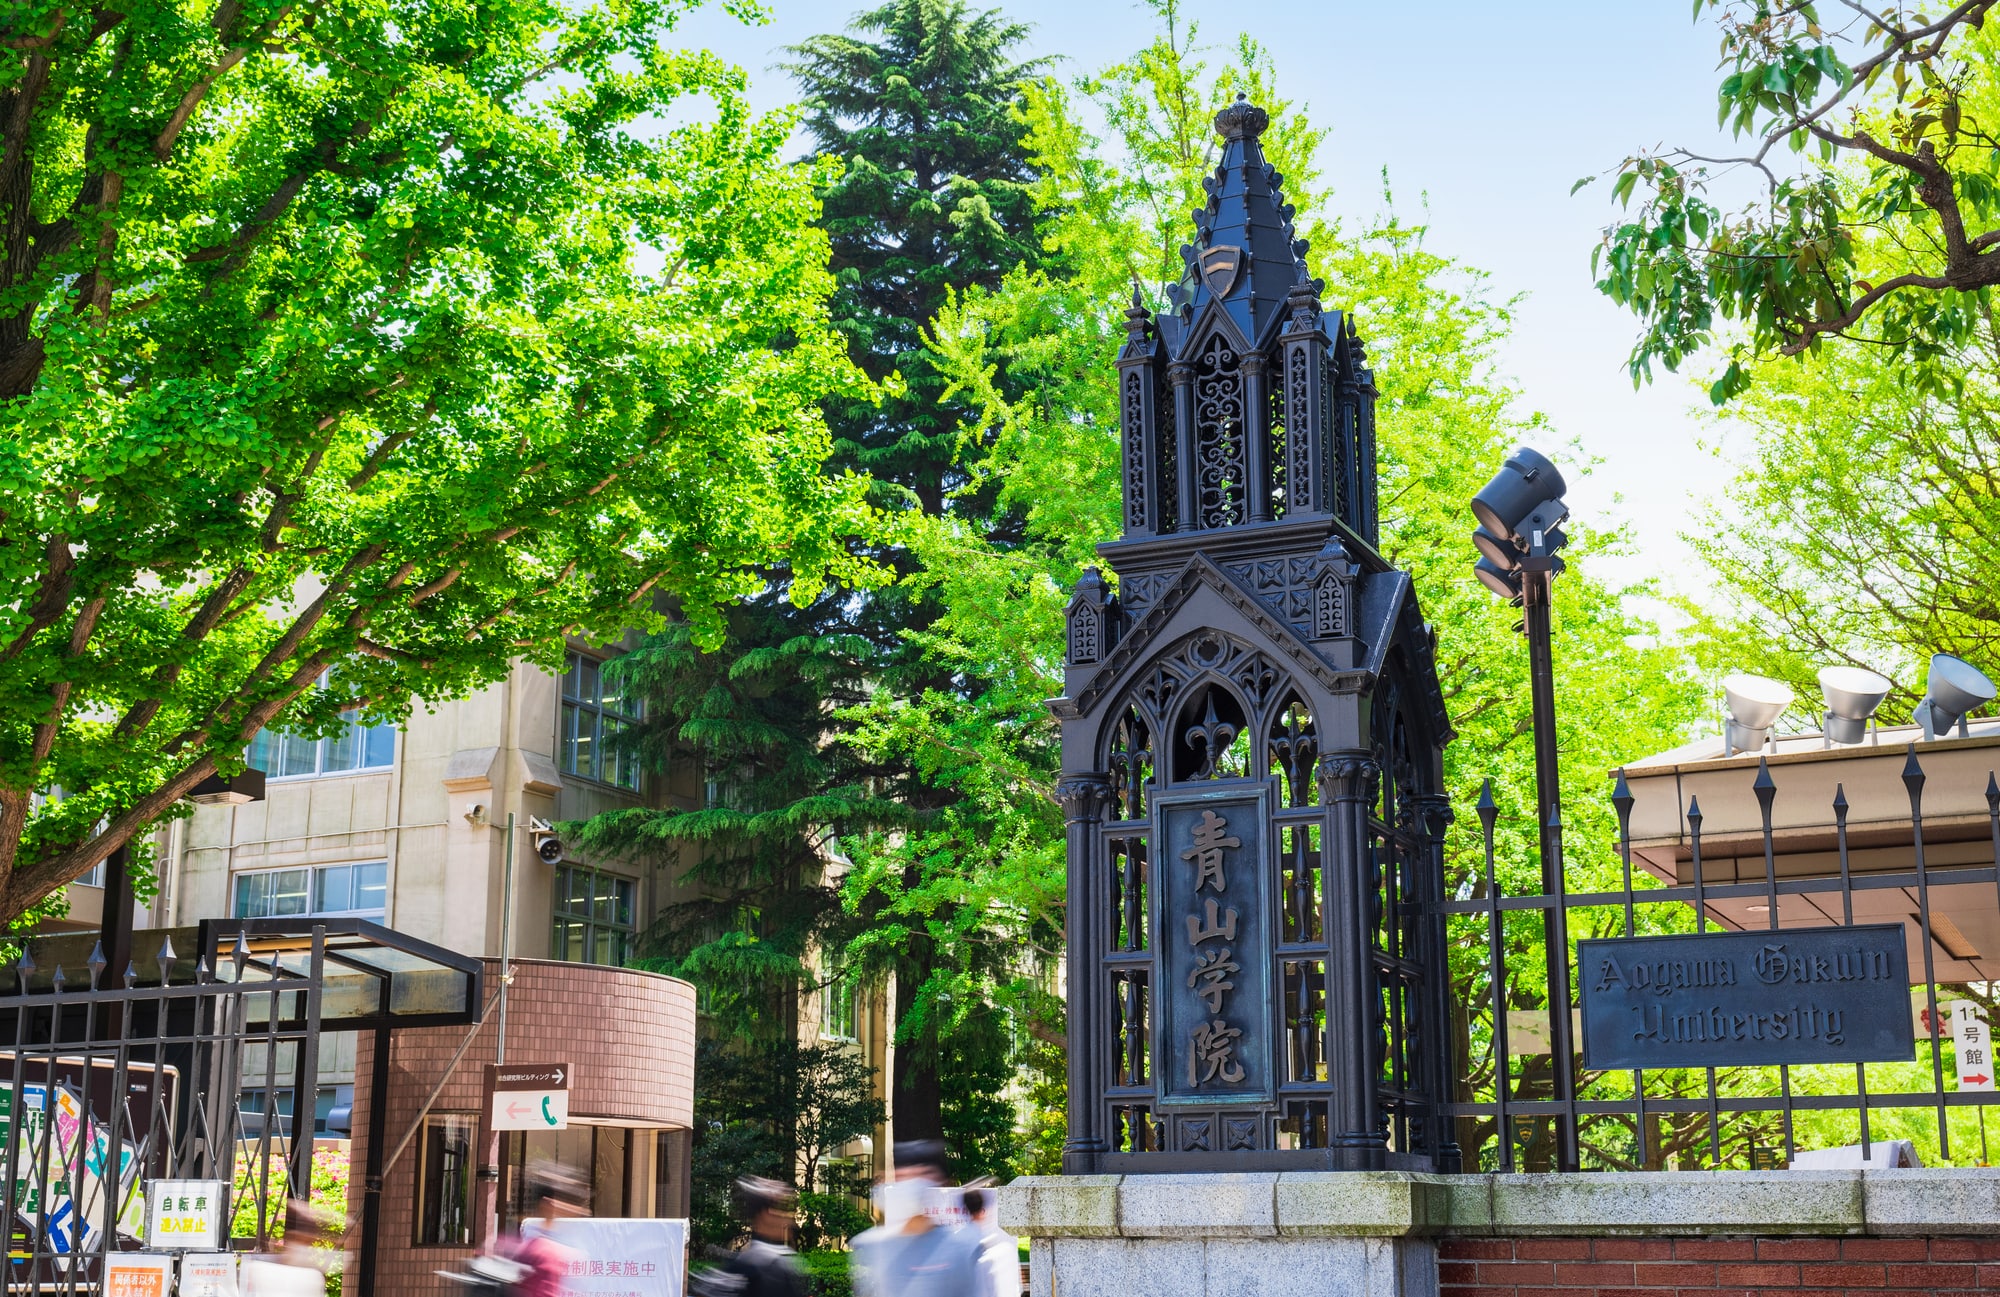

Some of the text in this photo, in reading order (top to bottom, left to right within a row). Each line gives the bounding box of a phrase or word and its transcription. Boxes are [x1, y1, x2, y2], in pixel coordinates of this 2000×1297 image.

[1181, 810, 1246, 1088] 青山学院
[1595, 943, 1893, 996] Aoyama Gakuin
[1631, 1002, 1847, 1045] University
[162, 1196, 207, 1212] 自転車
[160, 1217, 207, 1233] 進入禁止
[114, 1274, 157, 1286] 関係者以外
